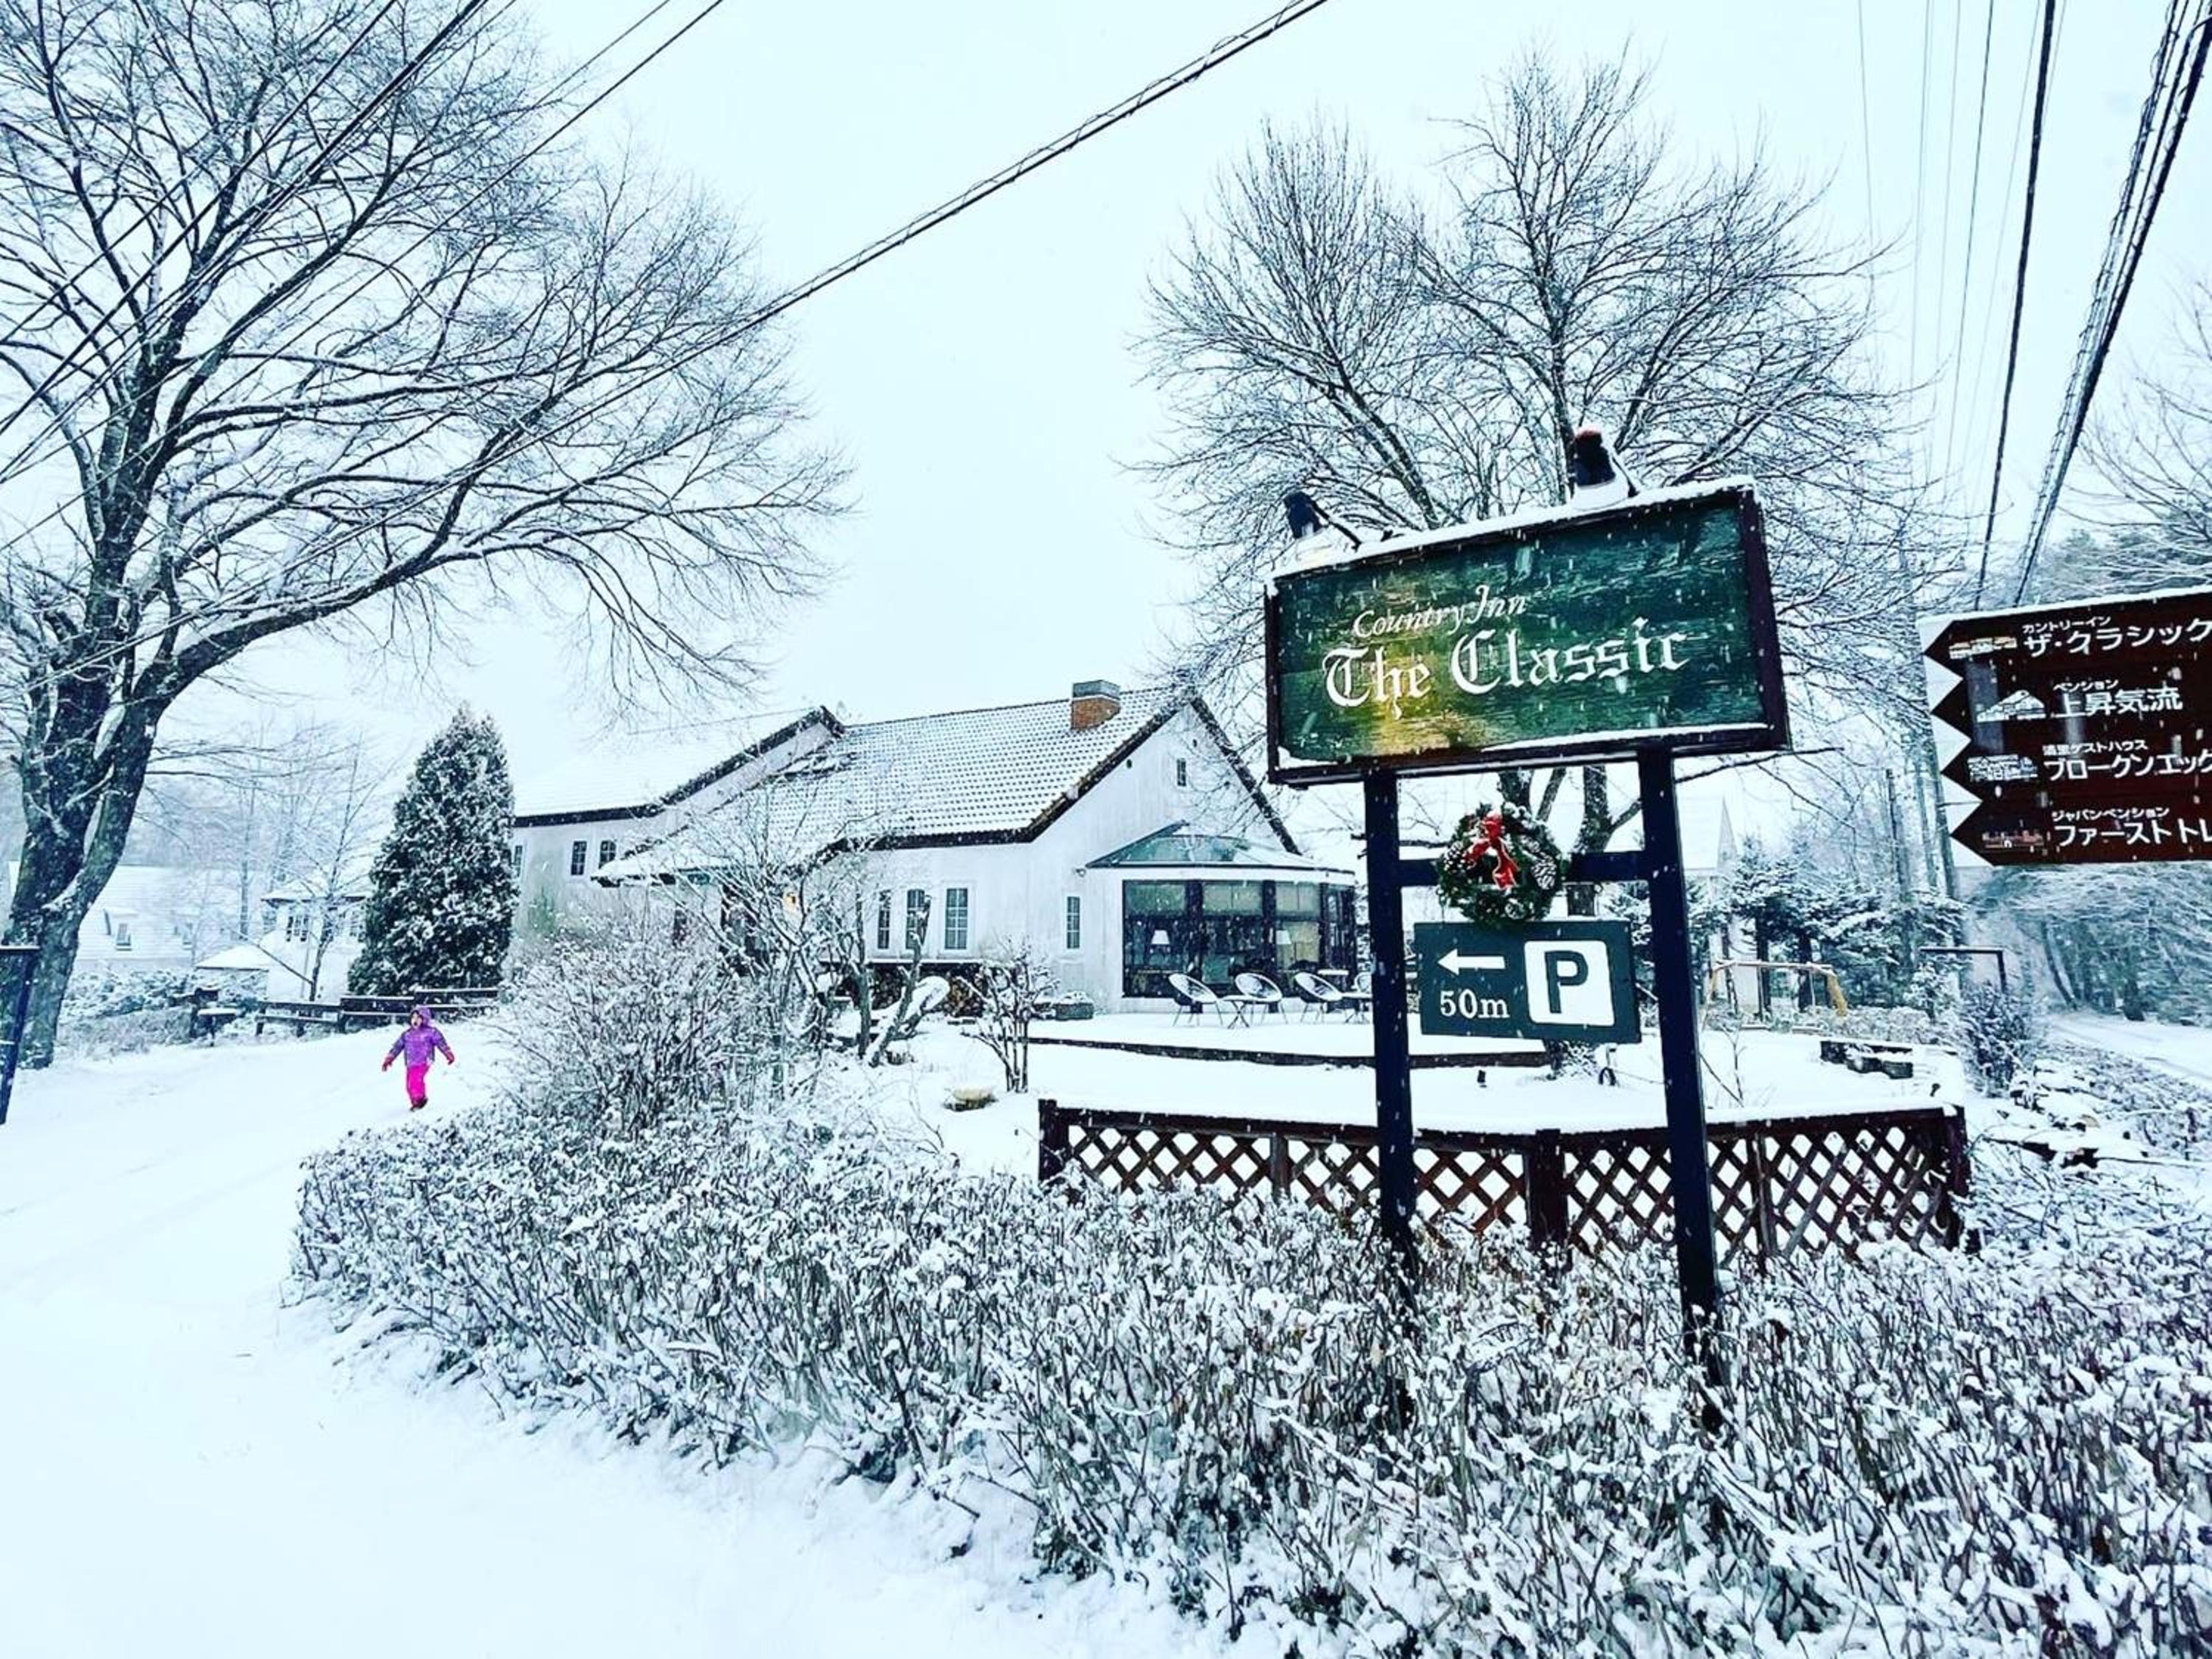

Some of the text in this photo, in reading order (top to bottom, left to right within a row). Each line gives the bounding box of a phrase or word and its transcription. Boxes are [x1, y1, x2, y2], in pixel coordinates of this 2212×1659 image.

[2023, 616, 2112, 634] カントリーイン
[2024, 618, 2212, 657] ザ・クラシック
[1322, 616, 1688, 718] The Classic
[2053, 679, 2119, 693] ペンション
[2053, 684, 2183, 717] 上昇気流
[2051, 807, 2170, 822] ジャパンペンション
[1545, 950, 1589, 1014] P
[1439, 989, 1510, 1019] 50m
